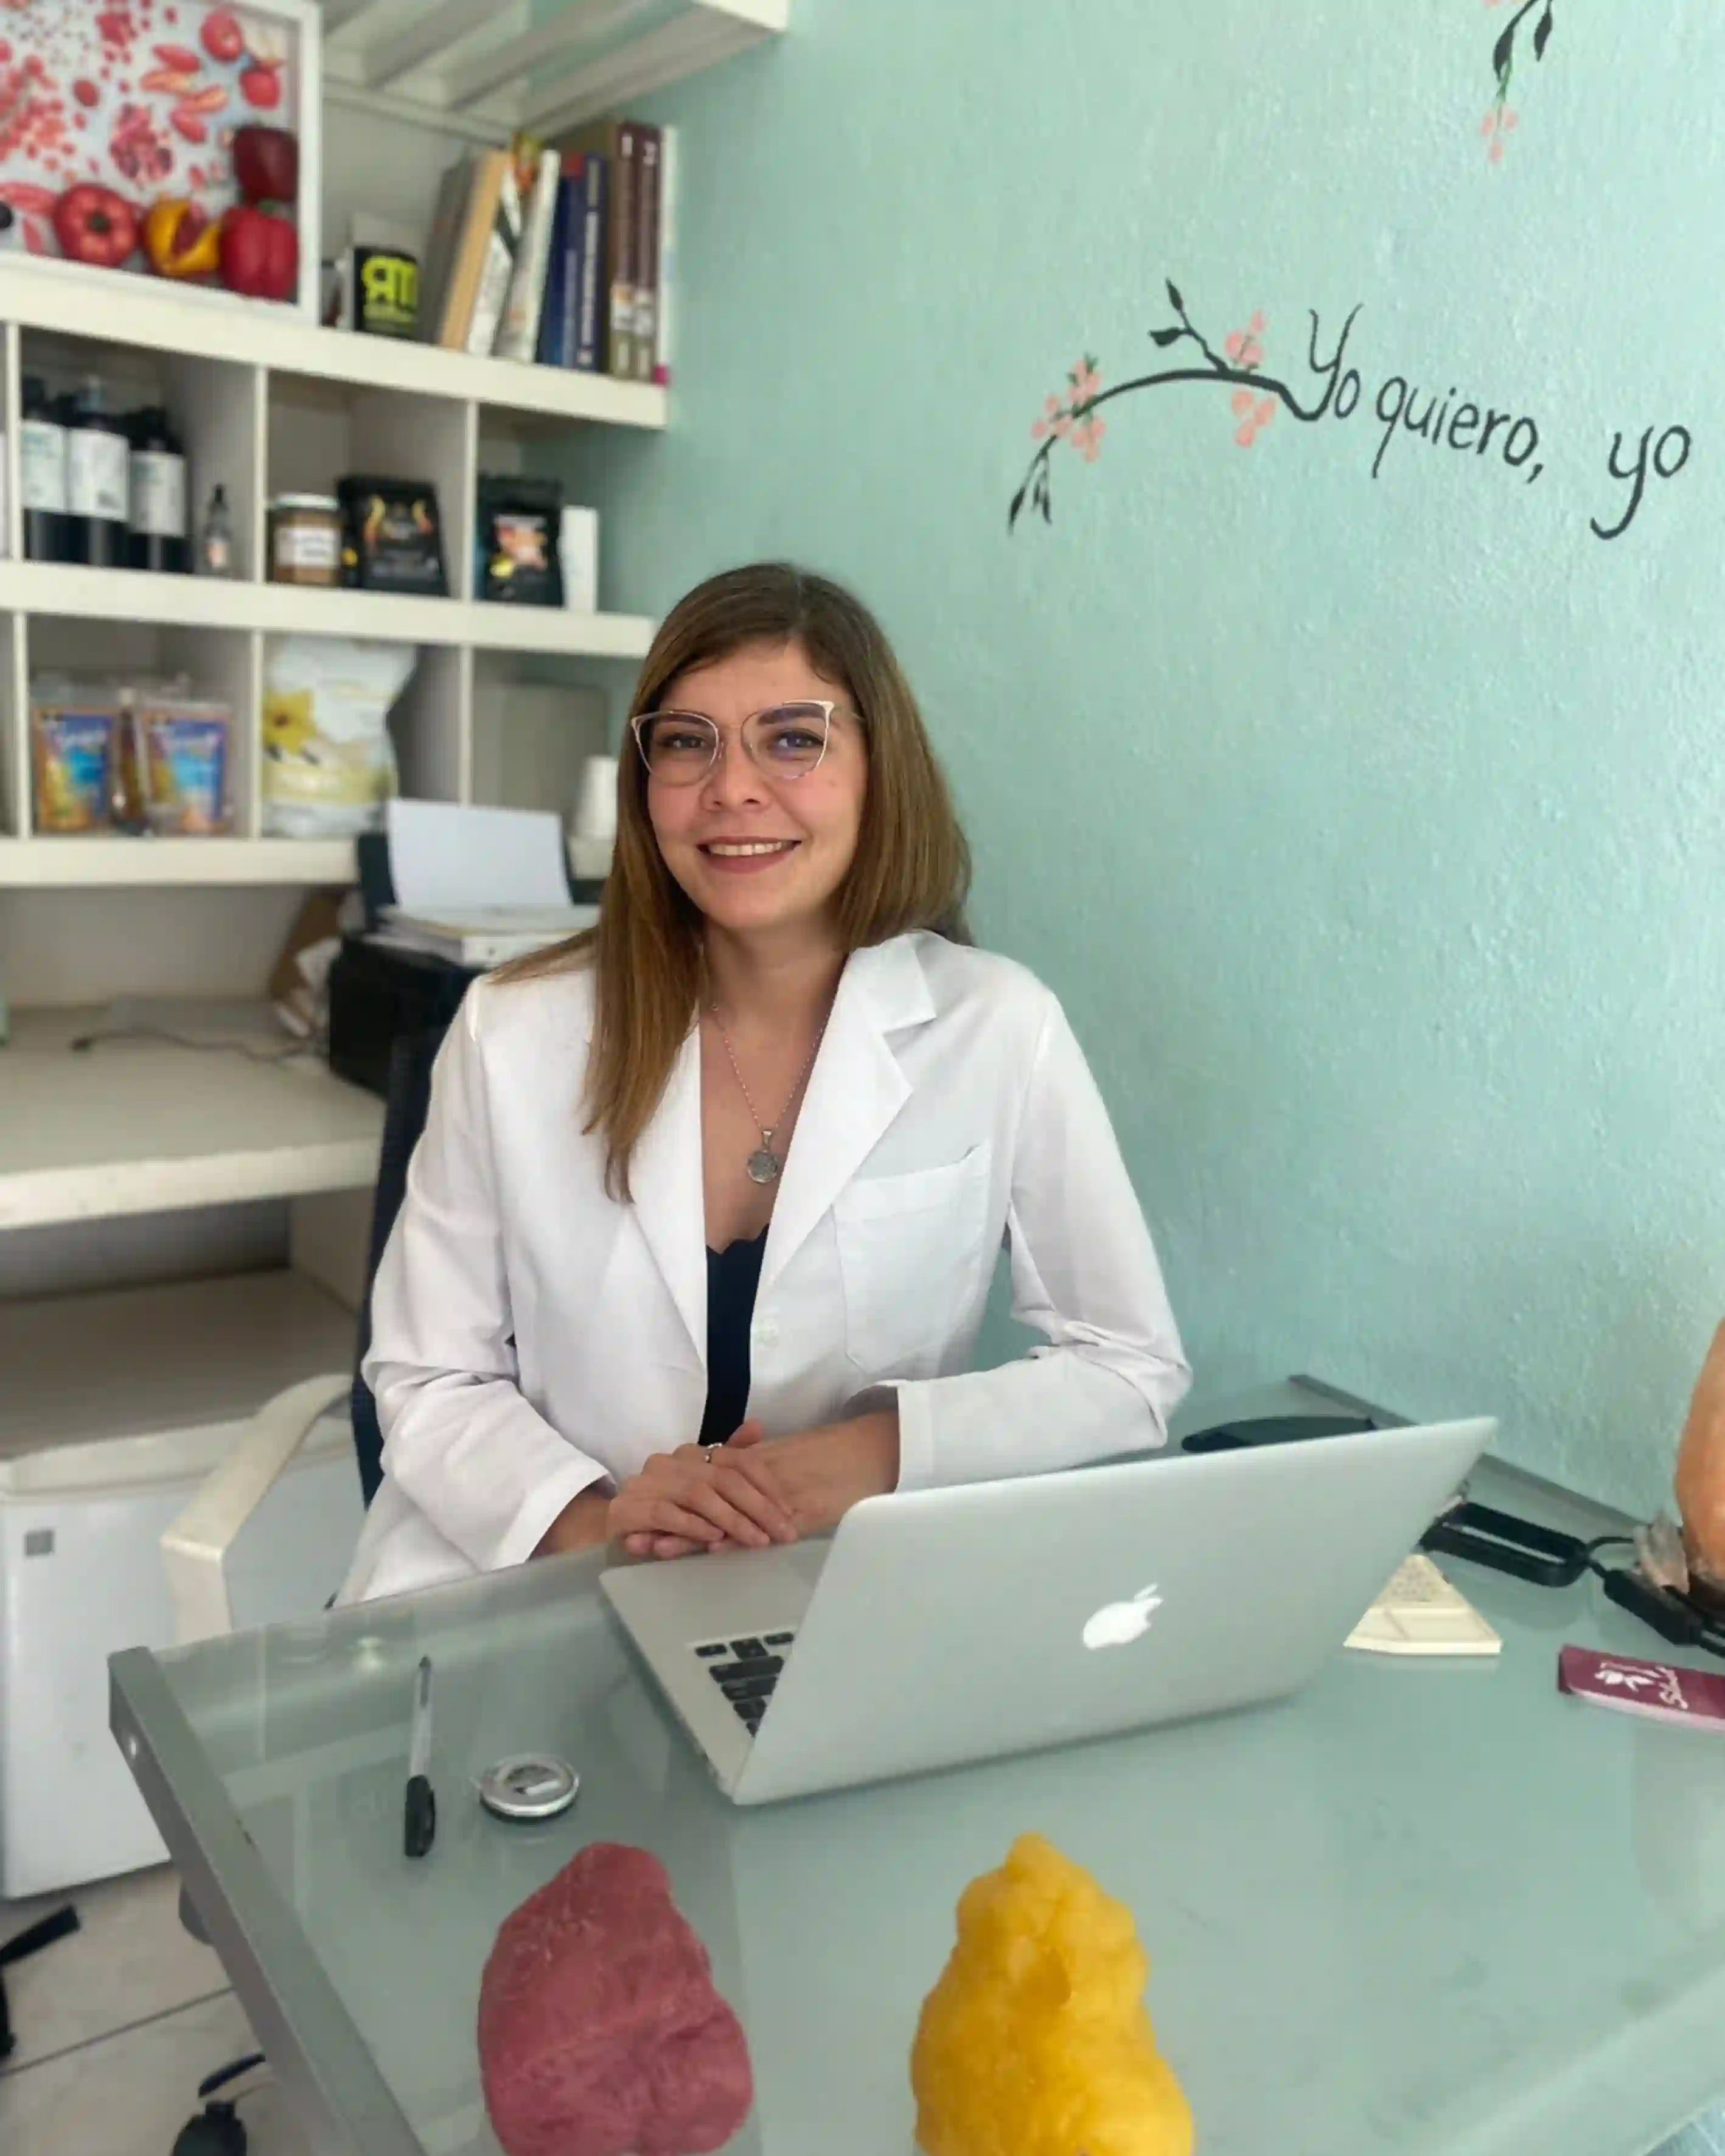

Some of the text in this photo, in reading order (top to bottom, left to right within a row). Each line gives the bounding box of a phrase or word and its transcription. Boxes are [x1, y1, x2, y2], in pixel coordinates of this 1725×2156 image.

[1300, 303, 1692, 541] Yo quiero, yo
